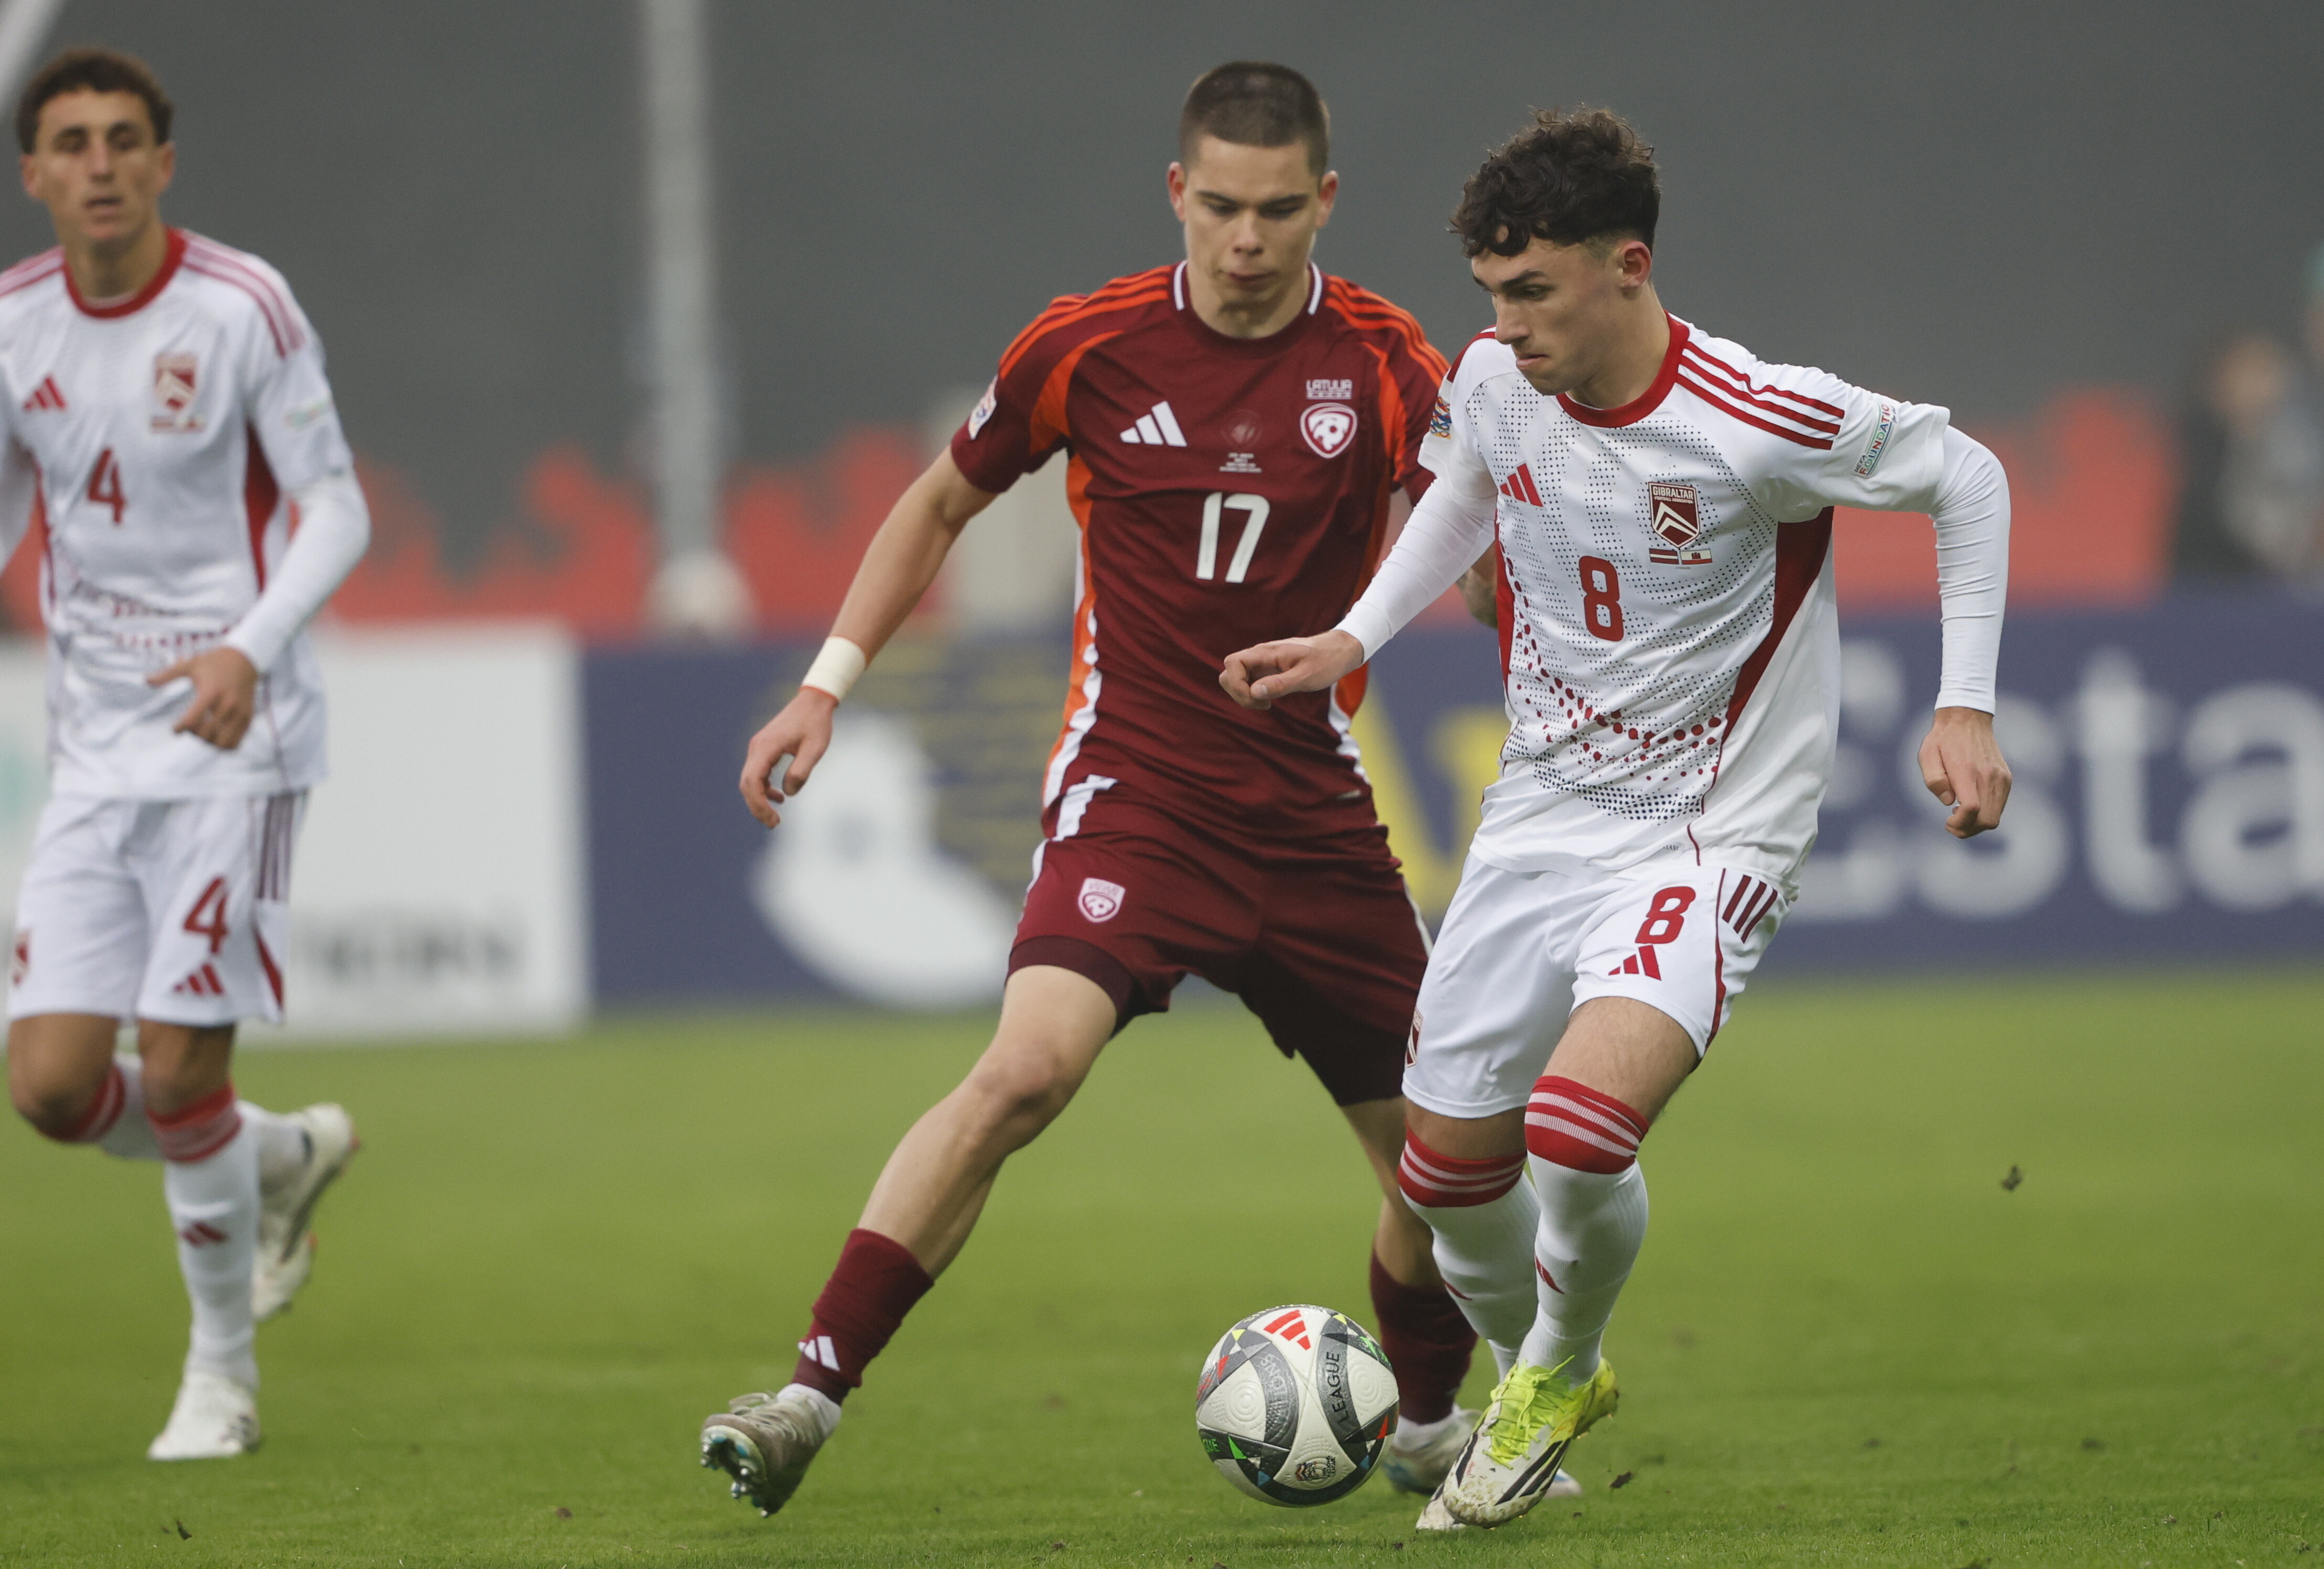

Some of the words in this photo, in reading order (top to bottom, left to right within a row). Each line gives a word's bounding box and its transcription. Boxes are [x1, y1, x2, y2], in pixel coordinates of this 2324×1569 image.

[1854, 455, 1866, 472] UEFA
[1859, 404, 1891, 475] FOUNDATIO
[87, 447, 126, 524] 4
[1653, 486, 1694, 500] GIBRALTAR
[1196, 492, 1270, 583] 17
[1578, 555, 1624, 642] 8
[183, 876, 231, 955] 4
[1634, 885, 1696, 944] 8
[1326, 1351, 1350, 1423] LEAGUE
